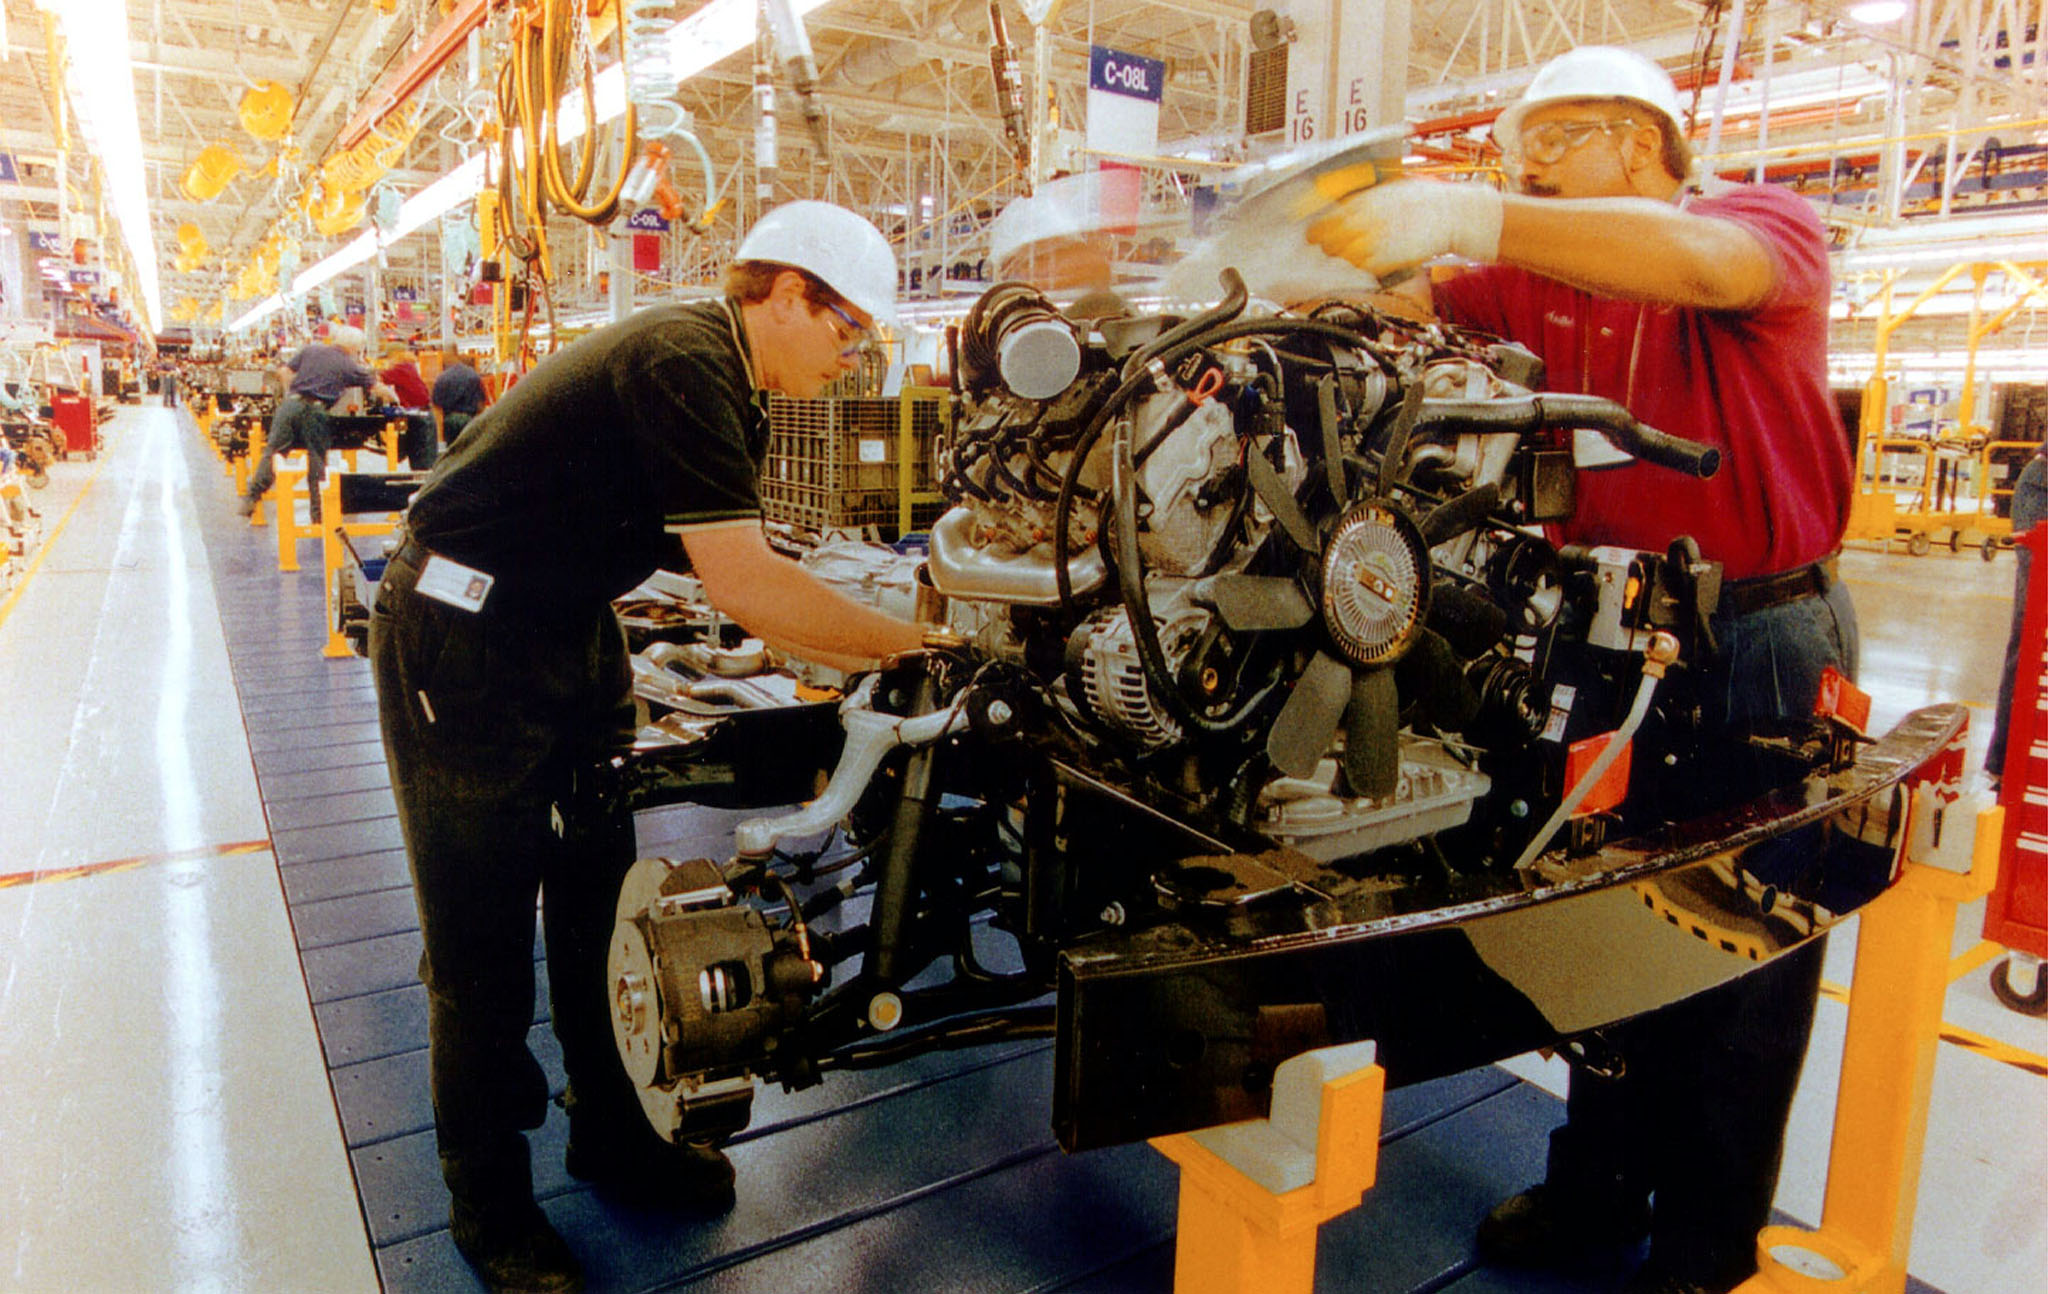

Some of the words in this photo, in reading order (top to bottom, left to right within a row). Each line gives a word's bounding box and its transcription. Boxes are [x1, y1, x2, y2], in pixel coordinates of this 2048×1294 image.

[1105, 60, 1149, 92] C-08L
[1296, 88, 1309, 115] E
[1350, 78, 1363, 105] E
[1293, 117, 1314, 144] 16
[1344, 107, 1367, 135] 16
